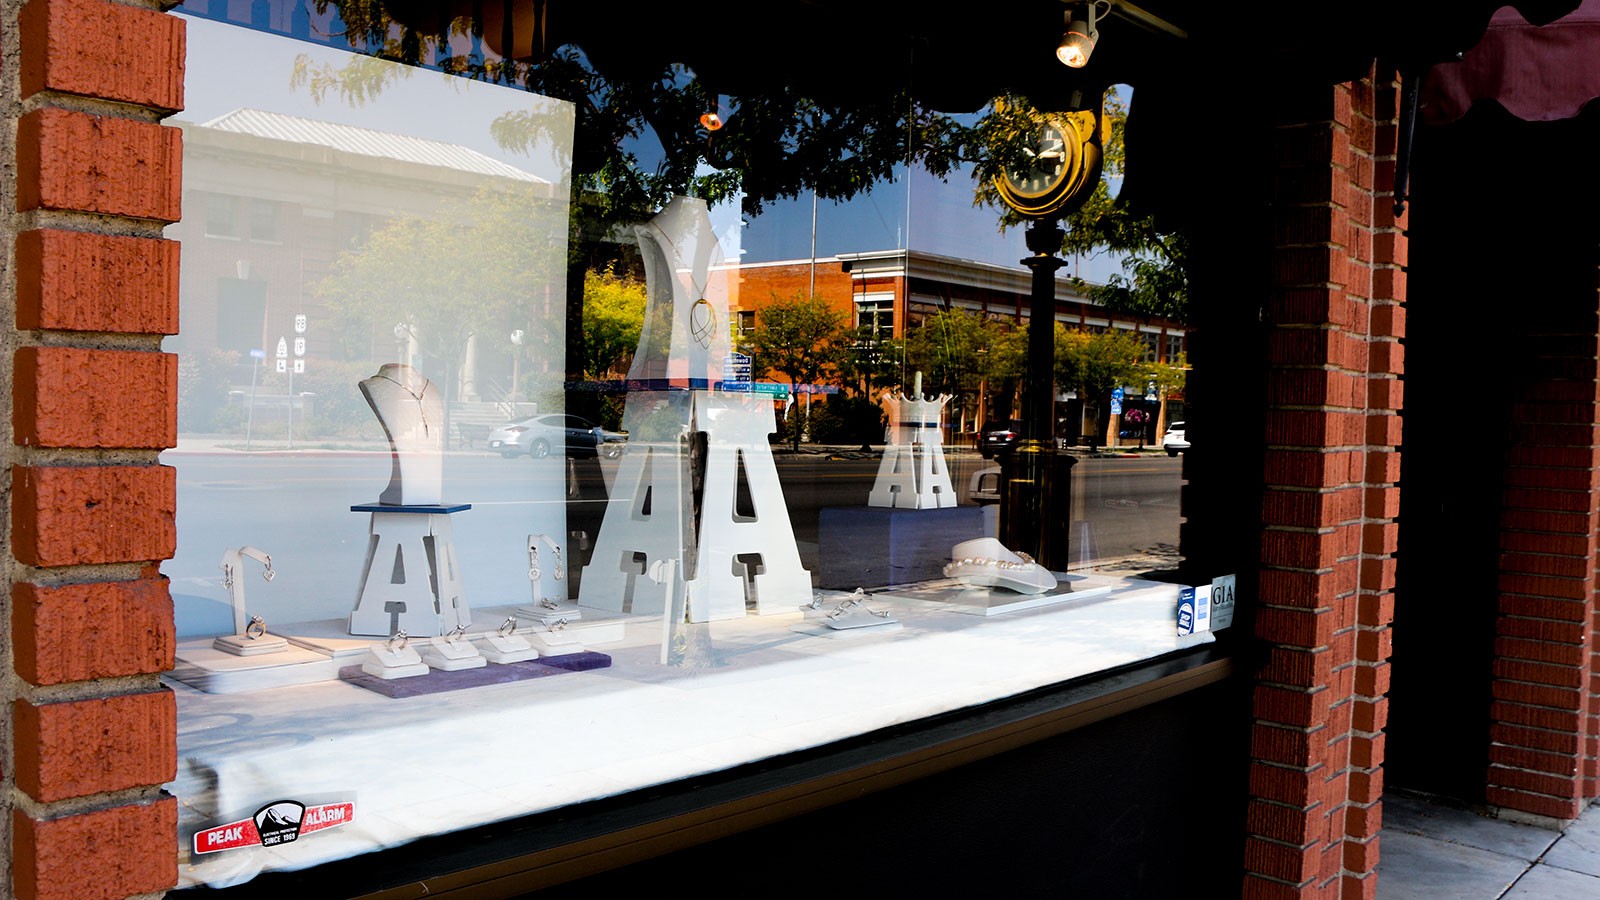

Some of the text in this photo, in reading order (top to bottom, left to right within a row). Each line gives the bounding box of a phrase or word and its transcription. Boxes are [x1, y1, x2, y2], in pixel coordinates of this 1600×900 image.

[1213, 585, 1233, 605] GIA
[305, 807, 345, 826] ALARM
[208, 827, 243, 846] PEAK
[264, 832, 296, 846] SINCE 1969
